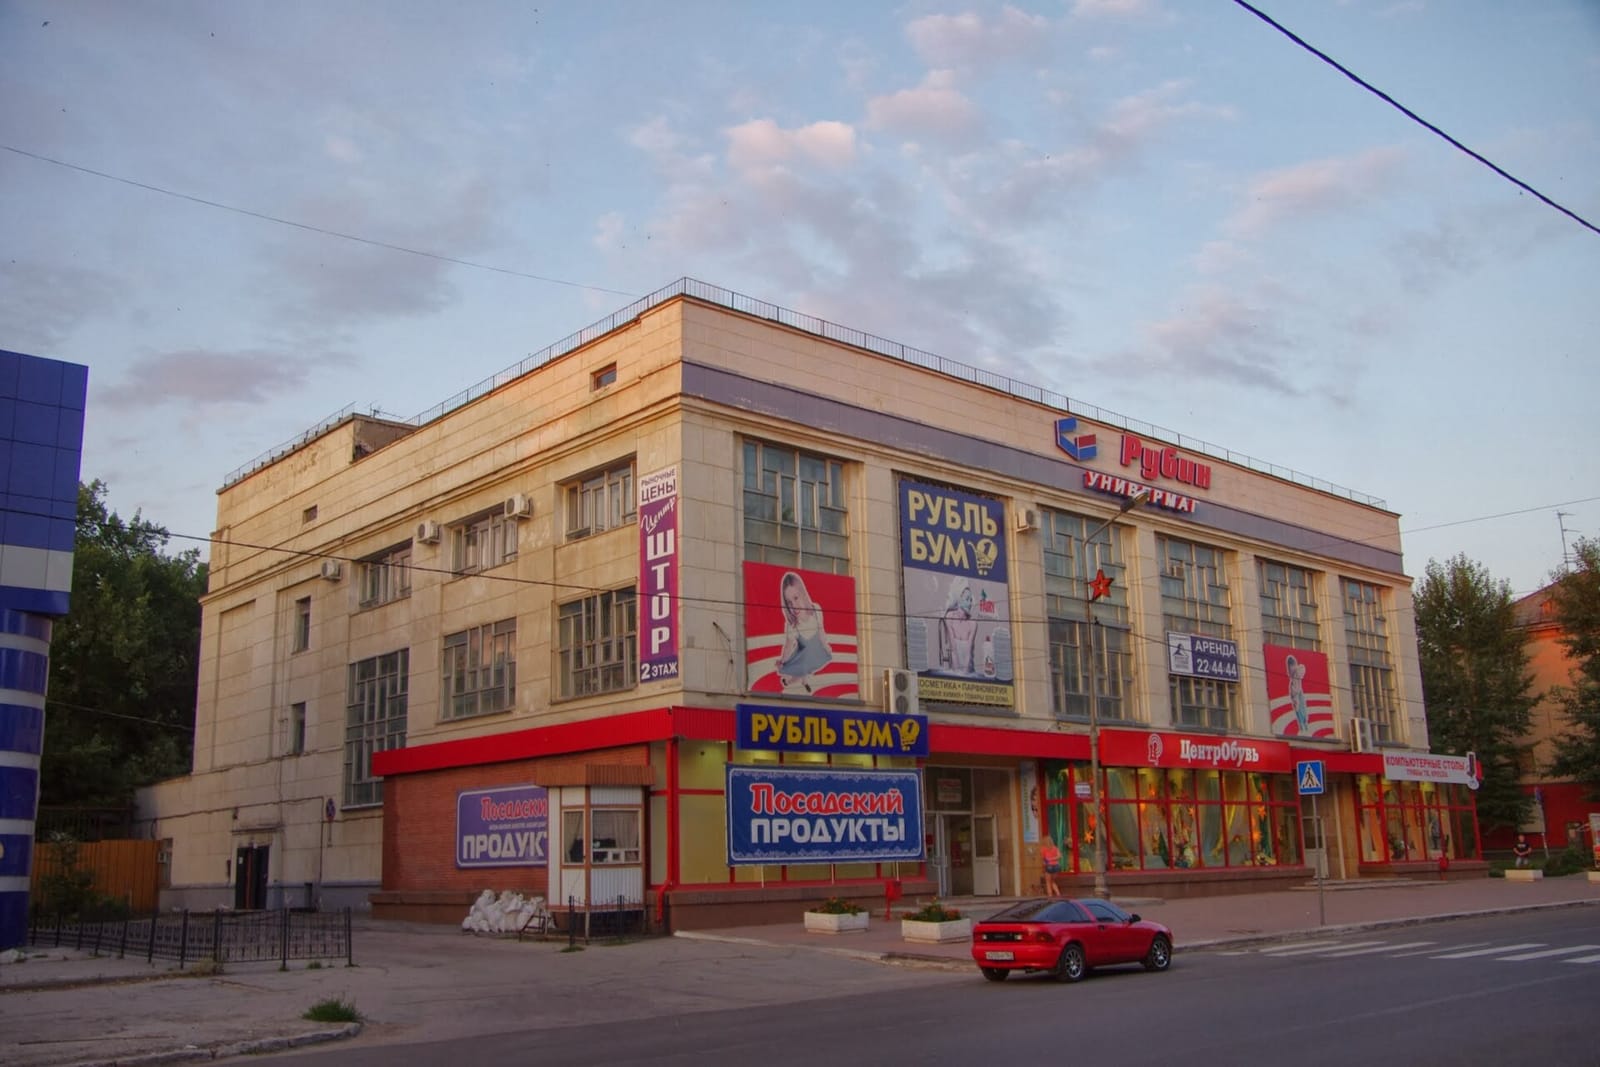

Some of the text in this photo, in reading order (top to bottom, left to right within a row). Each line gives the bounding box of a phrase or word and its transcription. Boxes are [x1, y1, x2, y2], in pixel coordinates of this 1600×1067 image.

[1120, 434, 1211, 489] Рубин
[641, 469, 676, 486] РЫНОЧНЫЕ
[641, 478, 677, 502] ЦЕНЫ
[908, 490, 997, 537] РУБЛЬ
[910, 528, 970, 570] БУМ
[647, 528, 675, 655] ШТОР
[1195, 640, 1236, 657] АРЕНДА
[641, 661, 678, 680] 2 ЭТАЖ
[919, 679, 957, 690] ОСМЕТИКА
[751, 713, 893, 748] РУБЛЬ БУМ
[1180, 739, 1260, 768] ЦентрОбувь
[1386, 757, 1465, 770] КОМПЬЮТЕРНЫЕ СТОЛЫ
[480, 795, 548, 821] Посадски
[749, 783, 904, 815] Посадский
[751, 818, 905, 844] ПРОДУКТЫ
[462, 831, 547, 860] ПРОДУК
